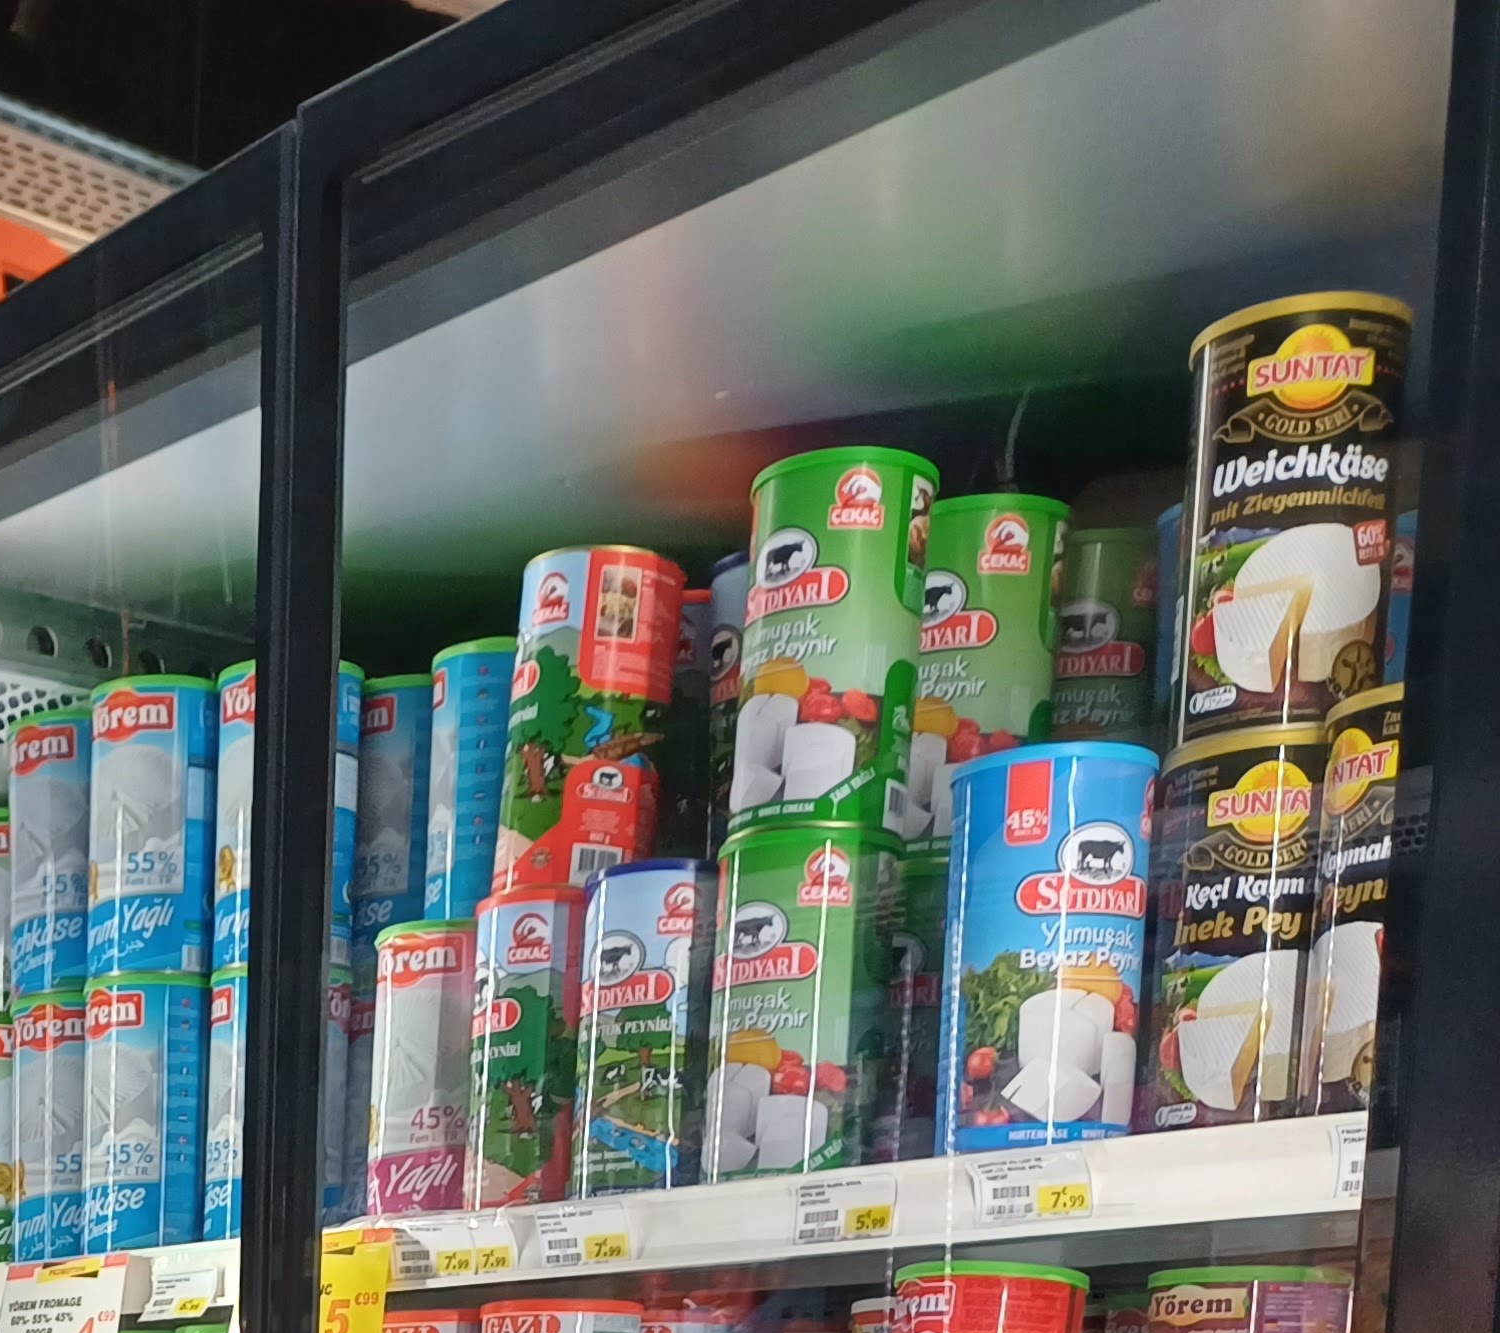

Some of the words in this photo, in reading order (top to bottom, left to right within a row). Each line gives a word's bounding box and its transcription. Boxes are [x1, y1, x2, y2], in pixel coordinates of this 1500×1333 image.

[1255, 355, 1366, 388] SUNTAT
[1264, 413, 1310, 436] GOLD
[1213, 444, 1389, 497] Weichkäse
[1211, 499, 1237, 525] mit
[772, 635, 837, 660] Peynir
[921, 676, 986, 699] Peynir
[1007, 809, 1048, 830] 45%
[125, 851, 178, 874] 55%
[1224, 846, 1269, 867] GOLD
[121, 897, 174, 939] Yağlı
[1041, 921, 1135, 949] Yumuşak
[1019, 948, 1091, 971] Beyaz
[411, 1105, 465, 1130] 45%
[385, 1155, 458, 1201] Yağlı
[8, 1301, 38, 1312] YÖREM
[39, 1297, 82, 1309] FROMAGE
[354, 1292, 379, 1306] €99
[1153, 1295, 1233, 1316] Yörem
